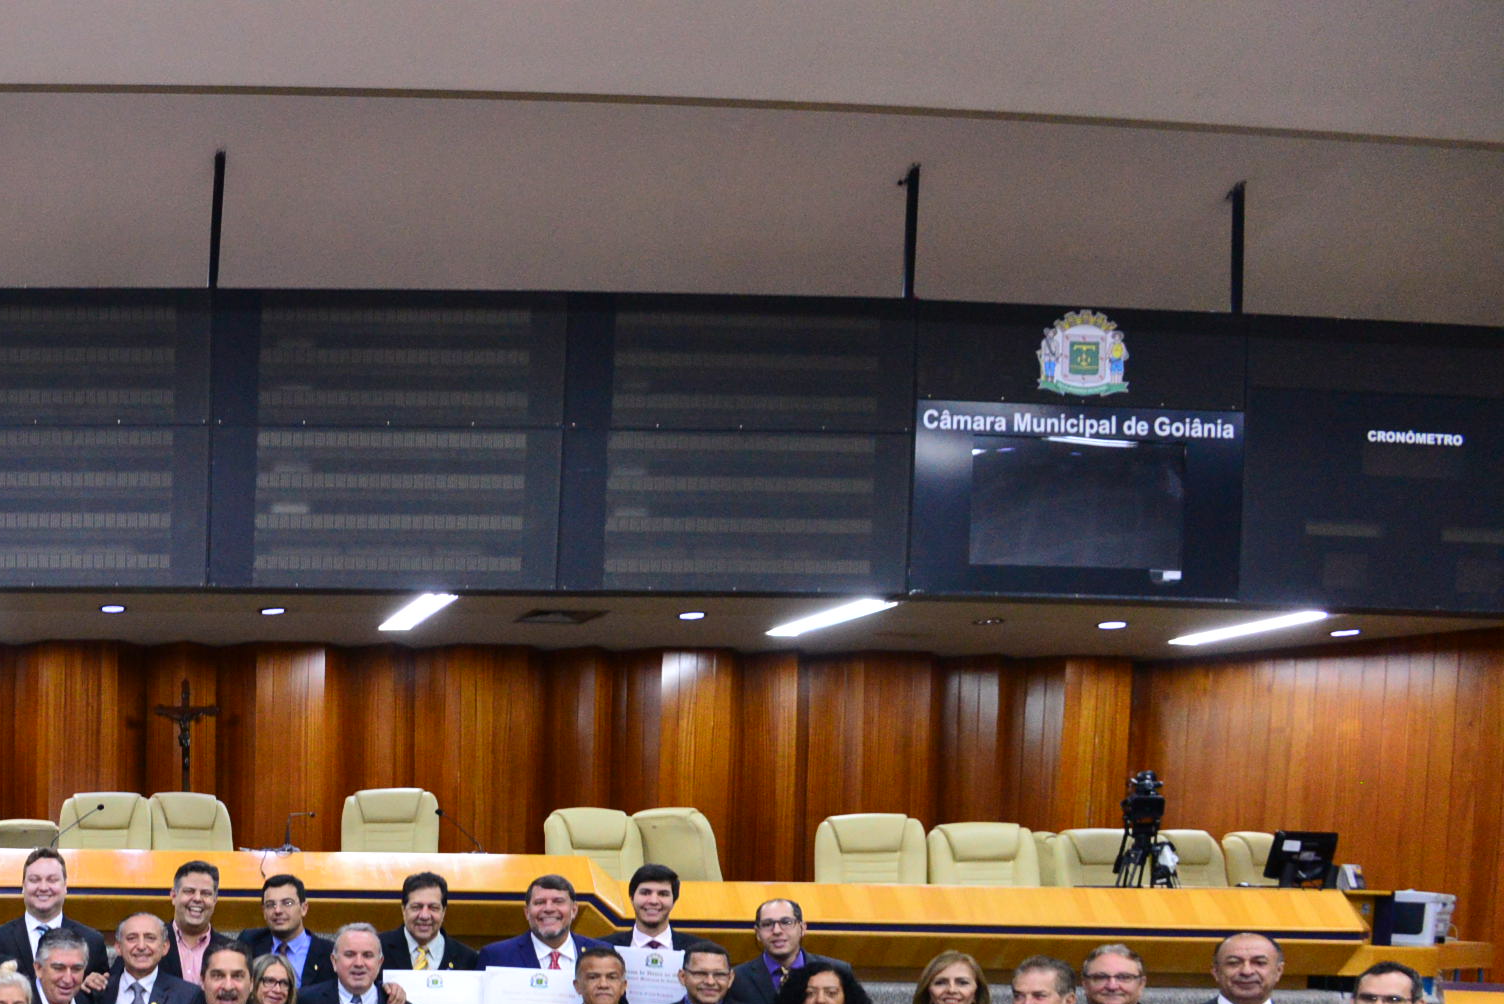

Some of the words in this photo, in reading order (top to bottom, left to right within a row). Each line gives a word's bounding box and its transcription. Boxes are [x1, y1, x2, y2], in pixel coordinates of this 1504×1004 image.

[923, 409, 1006, 431] Câmara
[1013, 412, 1117, 437] Municipal
[1122, 416, 1149, 436] de
[1153, 416, 1234, 440] Goiânia
[1367, 429, 1464, 446] CRONÔMETRO
